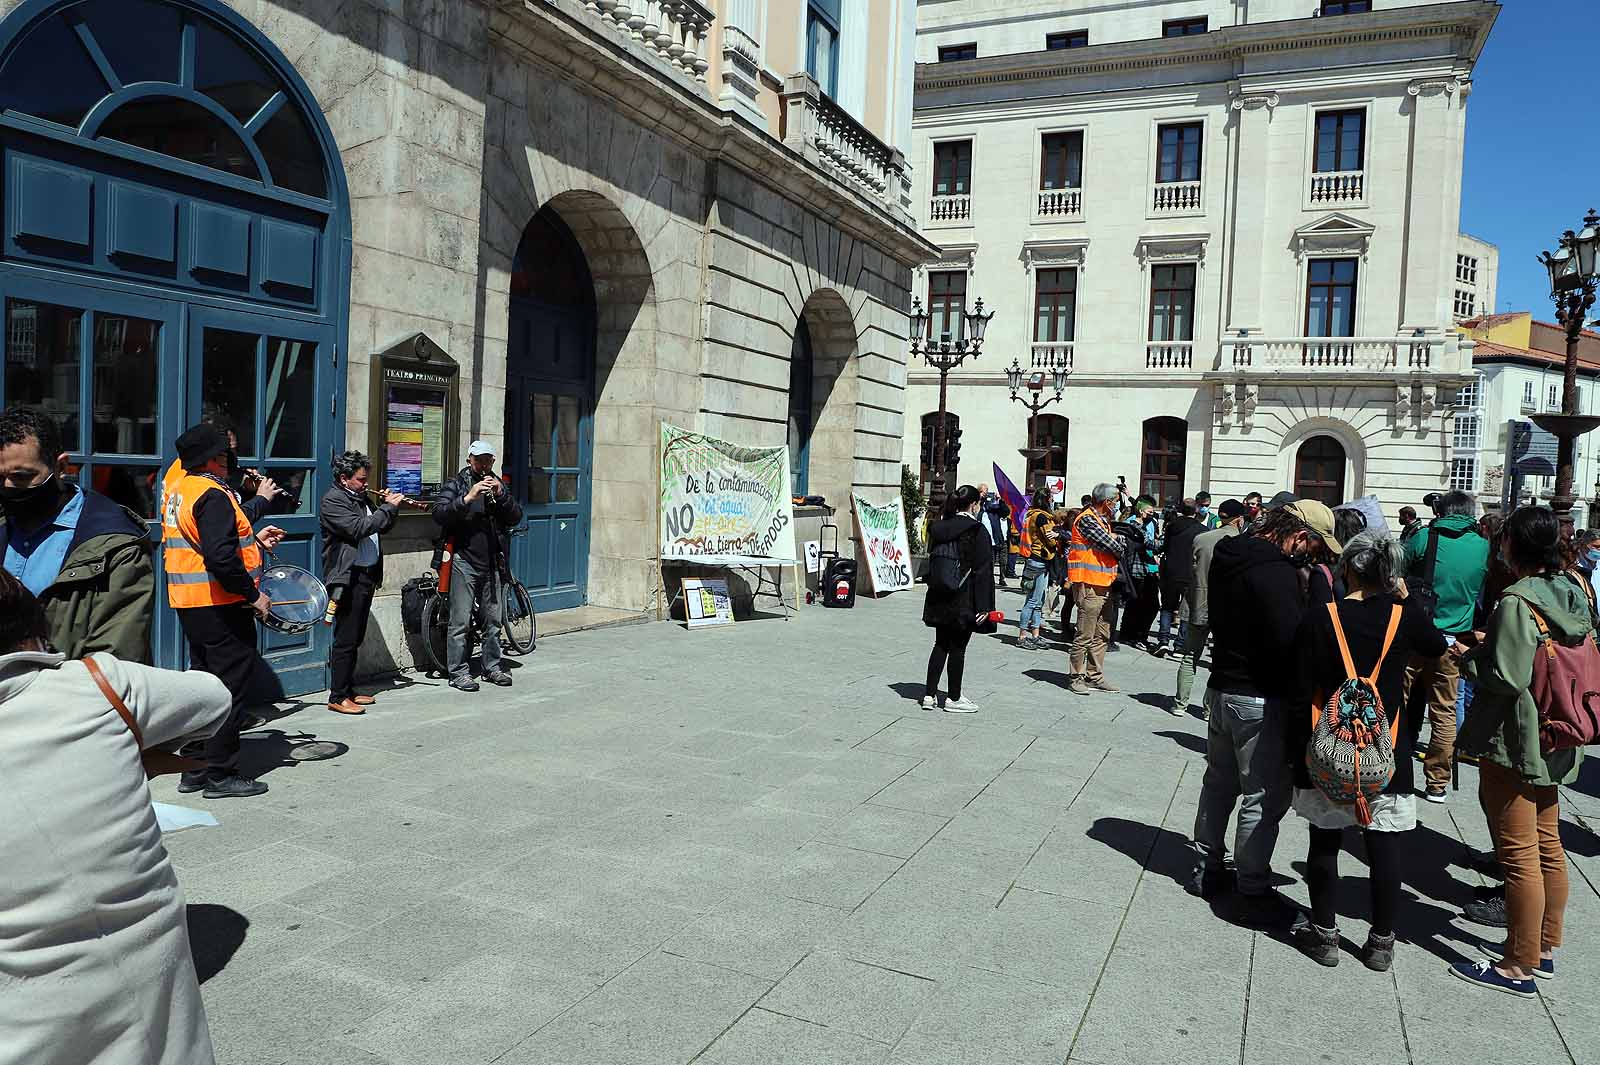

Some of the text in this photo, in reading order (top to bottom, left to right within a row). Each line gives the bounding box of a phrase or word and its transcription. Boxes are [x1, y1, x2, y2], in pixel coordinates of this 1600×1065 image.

[386, 368, 449, 383] TEATRO PRINCIPAL
[706, 471, 715, 494] la
[666, 503, 695, 542] NO
[760, 509, 789, 555] ERDOS
[718, 535, 744, 553] tierra
